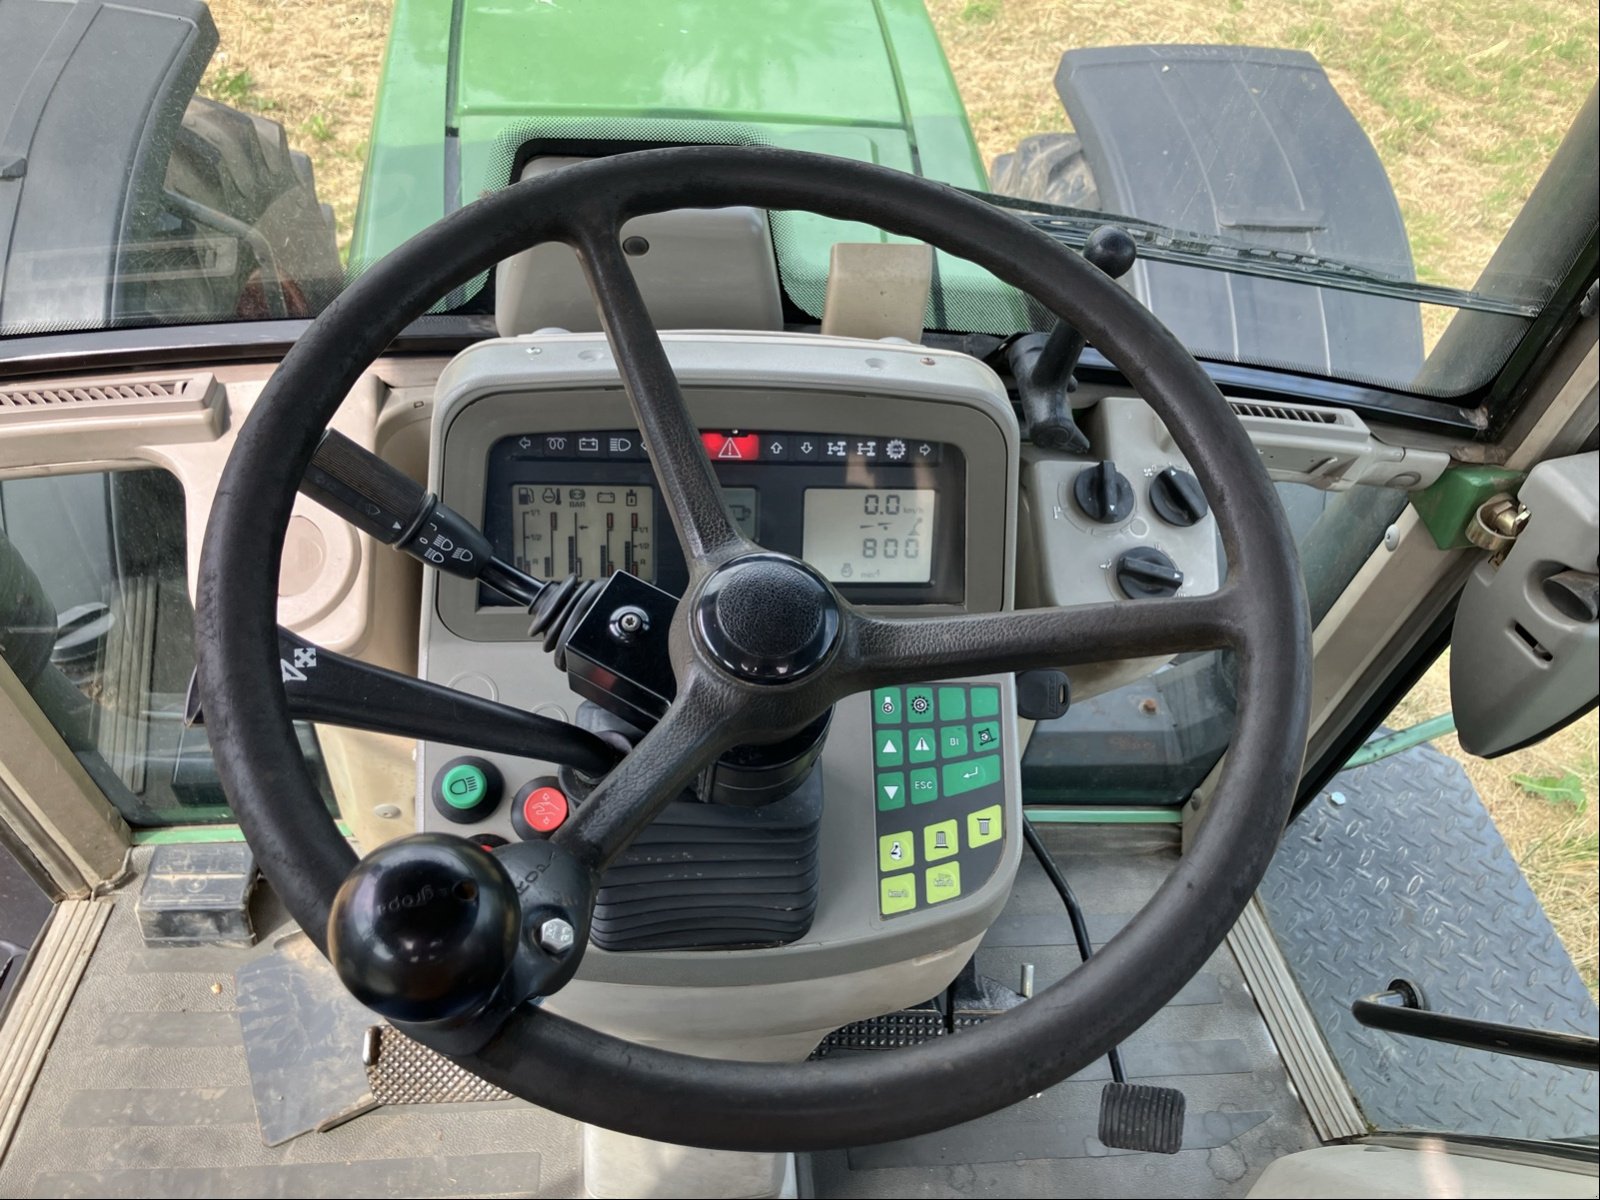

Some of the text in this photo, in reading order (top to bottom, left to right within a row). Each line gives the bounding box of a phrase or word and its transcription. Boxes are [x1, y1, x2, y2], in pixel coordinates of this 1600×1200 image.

[864, 494, 900, 515] 0.0
[862, 538, 919, 559] 800
[914, 780, 933, 790] ESC
